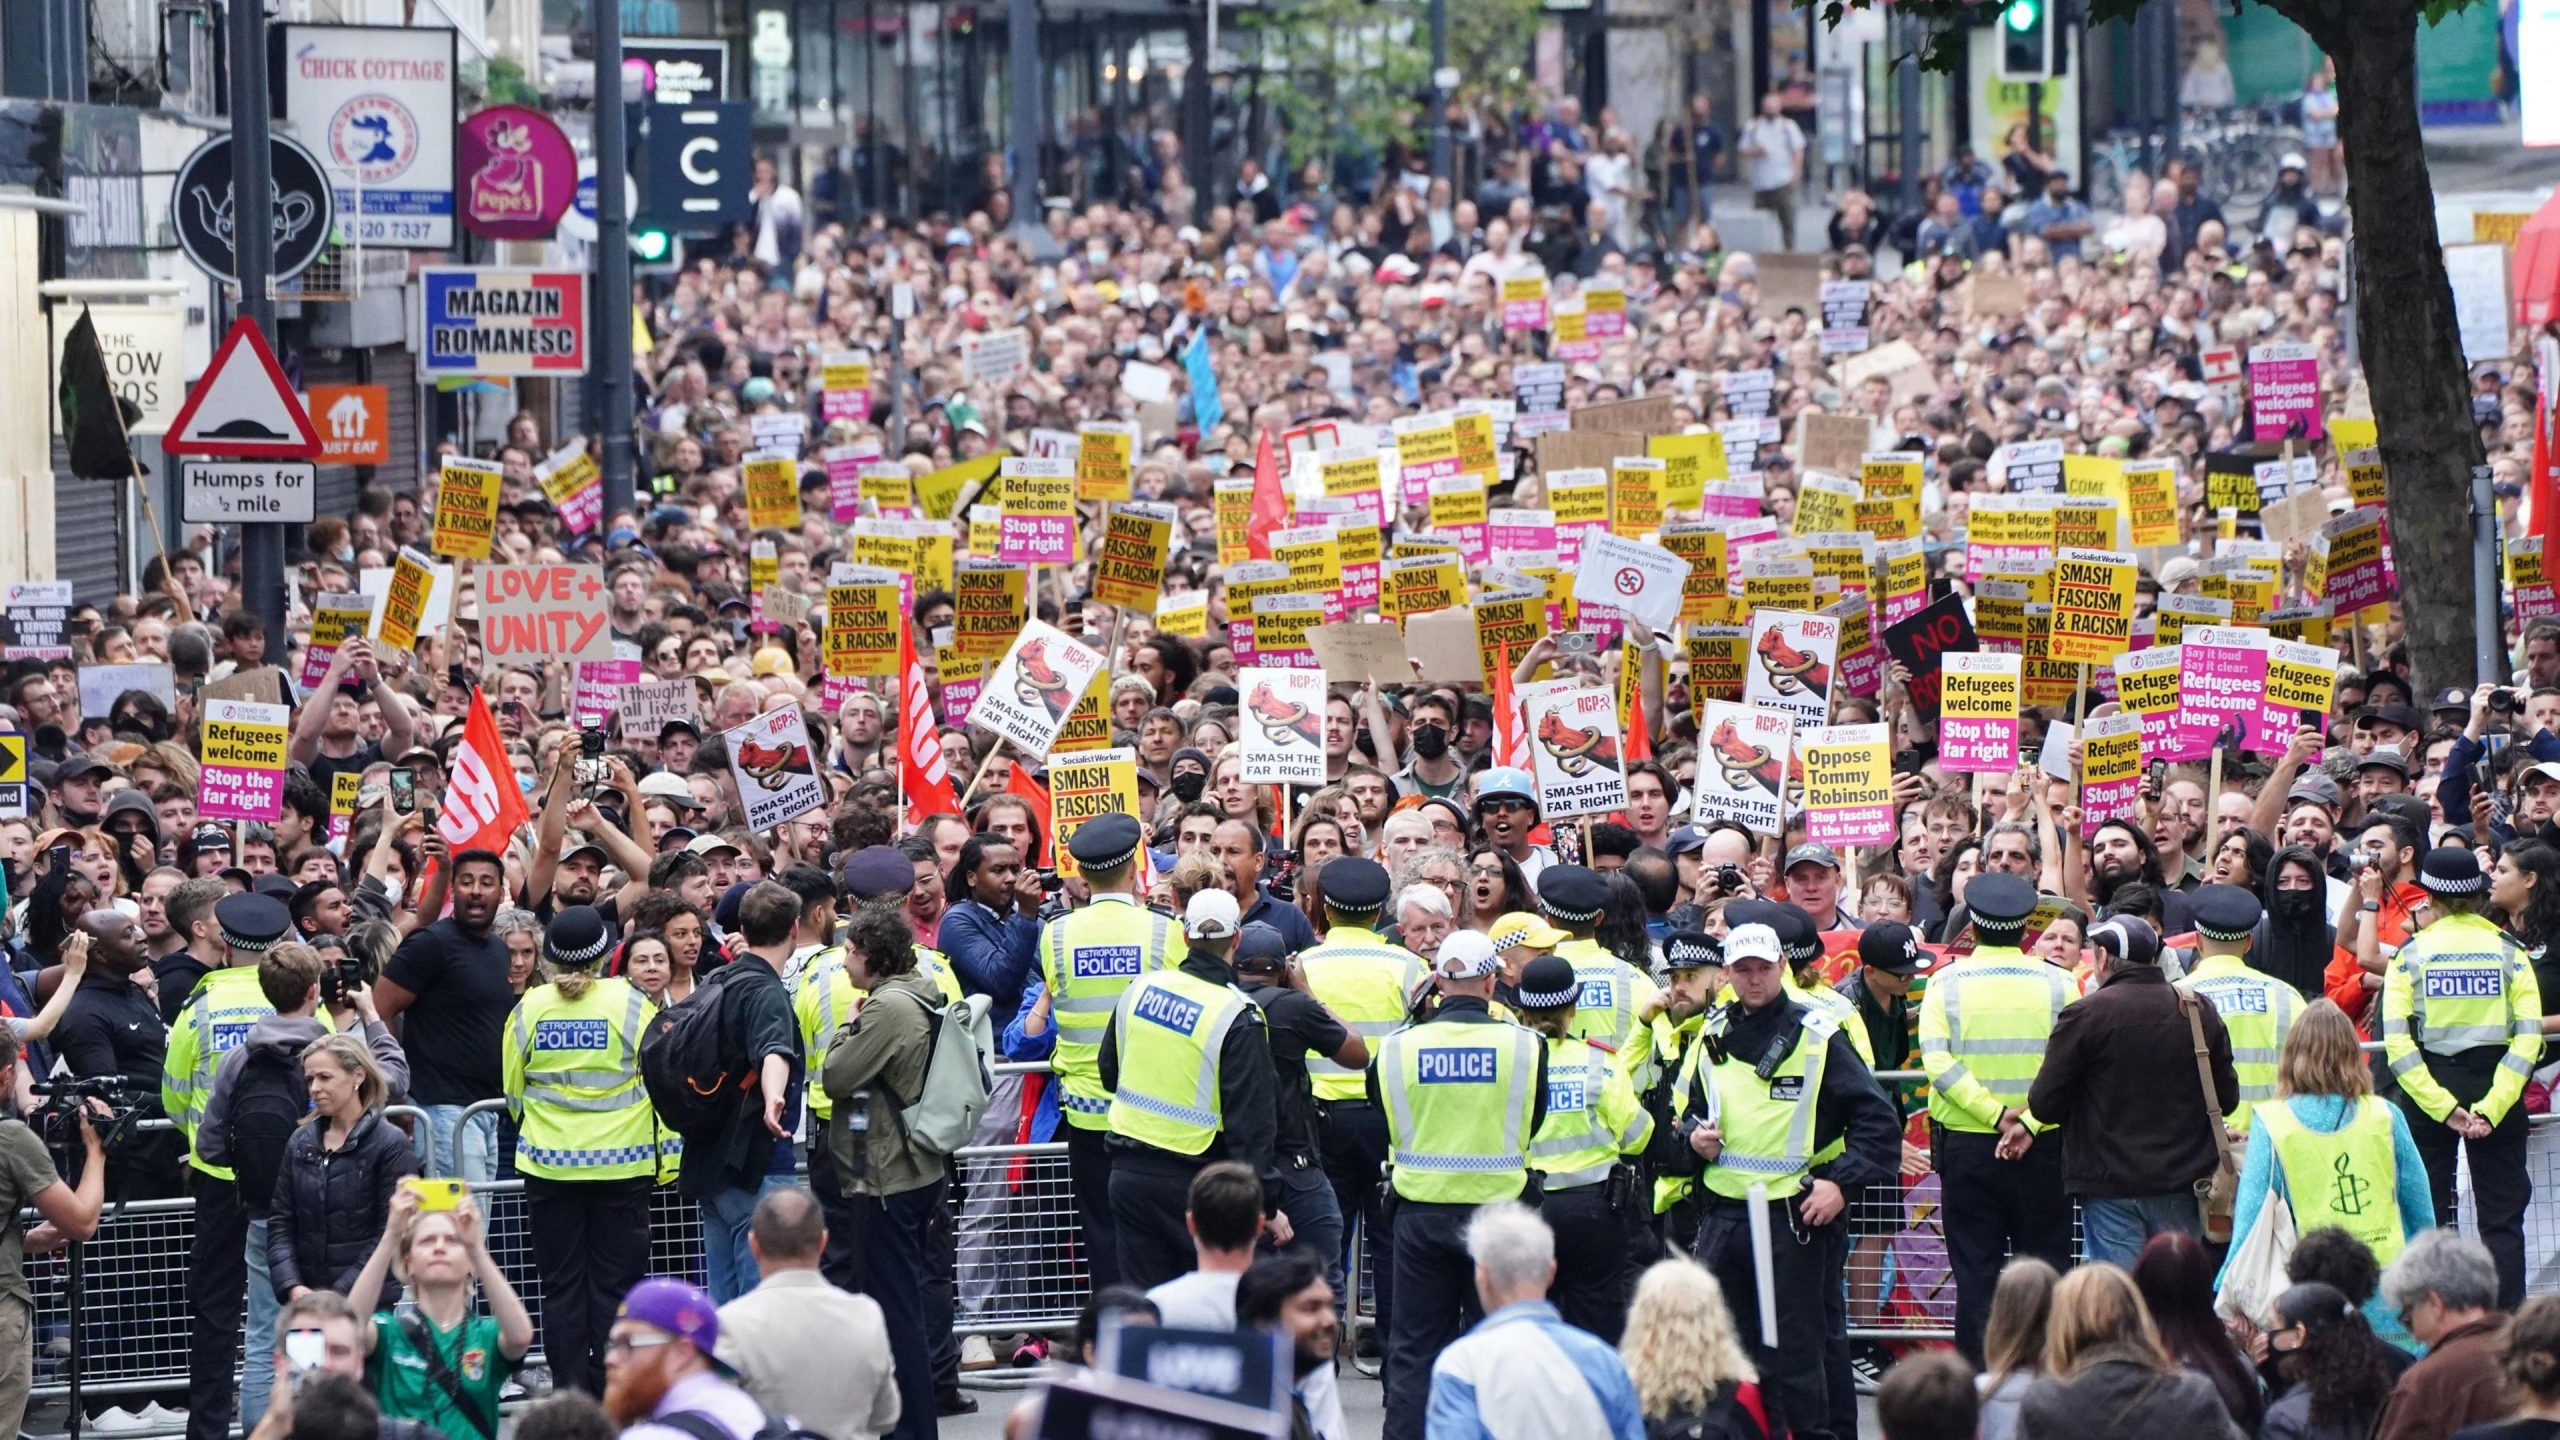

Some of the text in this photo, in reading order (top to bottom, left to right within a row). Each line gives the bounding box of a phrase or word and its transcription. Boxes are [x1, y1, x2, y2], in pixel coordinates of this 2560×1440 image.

[302, 58, 445, 81] CHICK COTTAGE
[680, 137, 720, 185] C
[478, 191, 533, 211] Pepe's
[393, 222, 431, 238] 7337
[447, 289, 560, 316] MAGAZIN
[103, 334, 135, 348] THE
[435, 328, 574, 355] ROMANESC
[2254, 382, 2316, 397] Refugees
[2256, 396, 2314, 410] welcome
[2256, 411, 2287, 425] here
[352, 440, 378, 454] EAT
[193, 471, 304, 491] Humps for
[444, 470, 483, 489] SMASH
[1005, 480, 1070, 496] Refugees
[238, 496, 281, 513] mile
[441, 491, 489, 512] FASCISM
[1005, 496, 1067, 511] welcome
[1552, 491, 1604, 503] Refugees
[1555, 506, 1603, 517] welcome
[1801, 503, 1843, 518] RACISM
[438, 514, 492, 535] & RACISM
[1004, 519, 1064, 534] Stop the
[1004, 536, 1064, 554] far right
[1602, 541, 1634, 555] REFUGEES
[1632, 558, 1650, 569] SILLY
[2071, 552, 2126, 564] Socialist Worker
[2328, 547, 2377, 569] welcome
[961, 575, 1004, 589] SMASH
[2060, 564, 2112, 586] SMASH
[2329, 567, 2377, 591] Stop the
[486, 567, 576, 604] LOVE
[1747, 581, 1810, 596] Refugees
[831, 590, 876, 606] SMASH
[959, 596, 1013, 610] FASCISM
[2057, 588, 2122, 611] FASCISM
[35, 608, 66, 620] HOMES
[831, 611, 887, 628] FASCISM
[958, 616, 1020, 630] & RACISM
[1258, 615, 1321, 631] Refugees
[23, 621, 62, 633] SERVICES
[486, 611, 605, 655] UNITY
[2054, 613, 2128, 636] & RACISM
[20, 634, 57, 645] FOR ALL!
[832, 632, 896, 650] & RACISM
[1912, 615, 1960, 660] NO
[2228, 638, 2250, 646] RACISM
[1063, 645, 1085, 665] RCP
[2185, 648, 2241, 661] Say it loud
[2185, 660, 2248, 673] Say it clear:
[1289, 674, 1311, 687] RCP
[1947, 677, 2014, 695] Refugees
[2184, 673, 2262, 693] Refugees
[620, 683, 687, 708] I thought
[1577, 696, 1599, 713] RCP
[1947, 696, 2011, 712] welcome
[2182, 692, 2256, 710] welcome
[622, 701, 687, 717] all lives
[986, 696, 1052, 739] SMASH THE
[2181, 709, 2220, 727] here
[769, 715, 789, 734] RCP
[979, 708, 1045, 750] FAR RIGHT!
[1944, 721, 2009, 742] Stop the
[208, 724, 283, 746] Refugees
[208, 744, 278, 763] welcome
[1943, 742, 2008, 762] far right
[2088, 738, 2139, 757] Refugees
[1062, 753, 1121, 765] Socialist Worker
[1247, 753, 1321, 764] SMASH THE
[1808, 749, 1871, 767] Oppose
[1246, 766, 1321, 777] FAR RIGHT!
[1809, 768, 1870, 787] Tommy
[2087, 760, 2137, 777] welcome
[205, 769, 273, 789] Stop the
[1054, 767, 1109, 791] SMASH
[1545, 780, 1622, 799] SMASH THE
[1810, 787, 1889, 805] Robinson
[2086, 785, 2118, 805] Stop
[203, 790, 271, 811] far right
[751, 781, 817, 817] SMASH THE
[1056, 792, 1125, 818] FASCISM
[1547, 793, 1624, 813] FAR RIGHT!
[1701, 794, 1777, 813] SMASH THE
[753, 792, 820, 829] FAR RIGHT!
[1699, 808, 1775, 827] FAR RIGHT!
[1810, 808, 1884, 824] Stop fascists
[1811, 821, 1890, 836] & the far right
[1735, 935, 1767, 948] POLICE
[1078, 948, 1137, 958] METROPOLITAN
[1077, 957, 1137, 975] POLICE
[2428, 969, 2499, 978] METROPOLITAN
[2428, 978, 2500, 996] POLICE
[1138, 993, 1199, 1030] POLICE
[536, 1021, 606, 1030] METROPOLITAN
[535, 1029, 607, 1049] POLICE
[1421, 1052, 1493, 1078] POLICE
